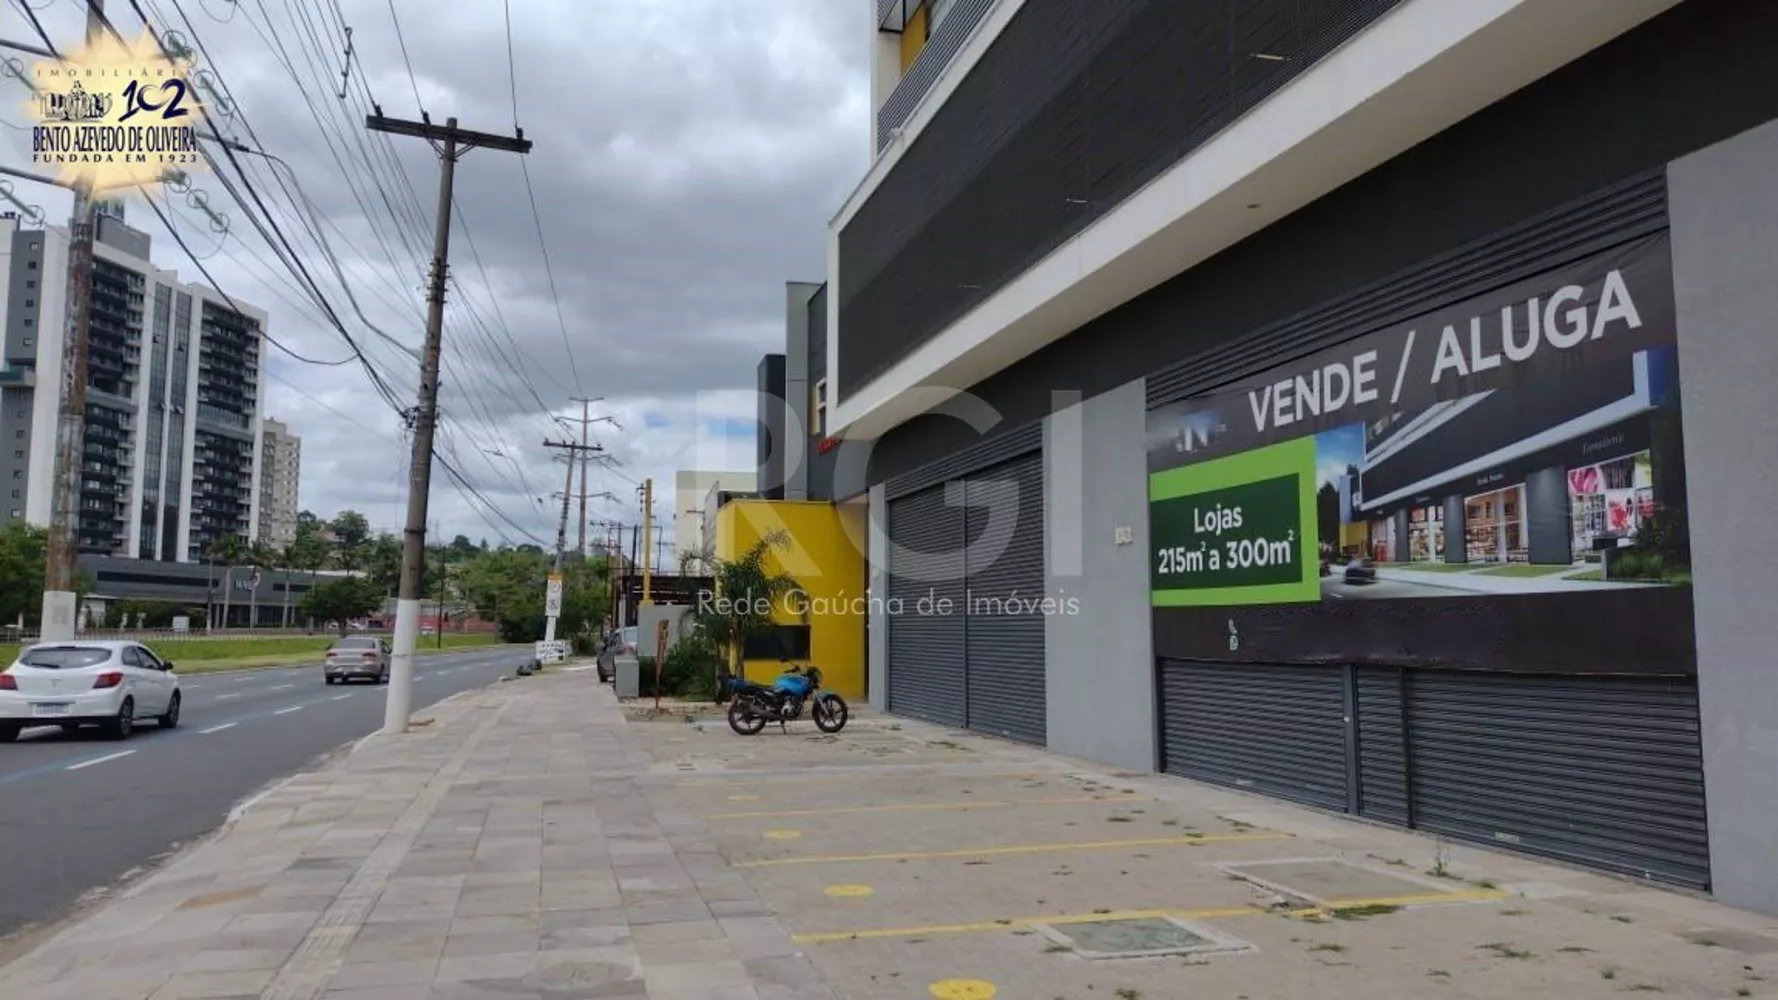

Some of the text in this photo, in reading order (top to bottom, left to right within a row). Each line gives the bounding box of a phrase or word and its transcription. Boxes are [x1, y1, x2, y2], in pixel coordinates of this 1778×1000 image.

[1249, 350, 1378, 432] VENDE
[1430, 269, 1642, 384] ALUGA
[1194, 503, 1243, 536] Lojas
[1209, 548, 1220, 571] a
